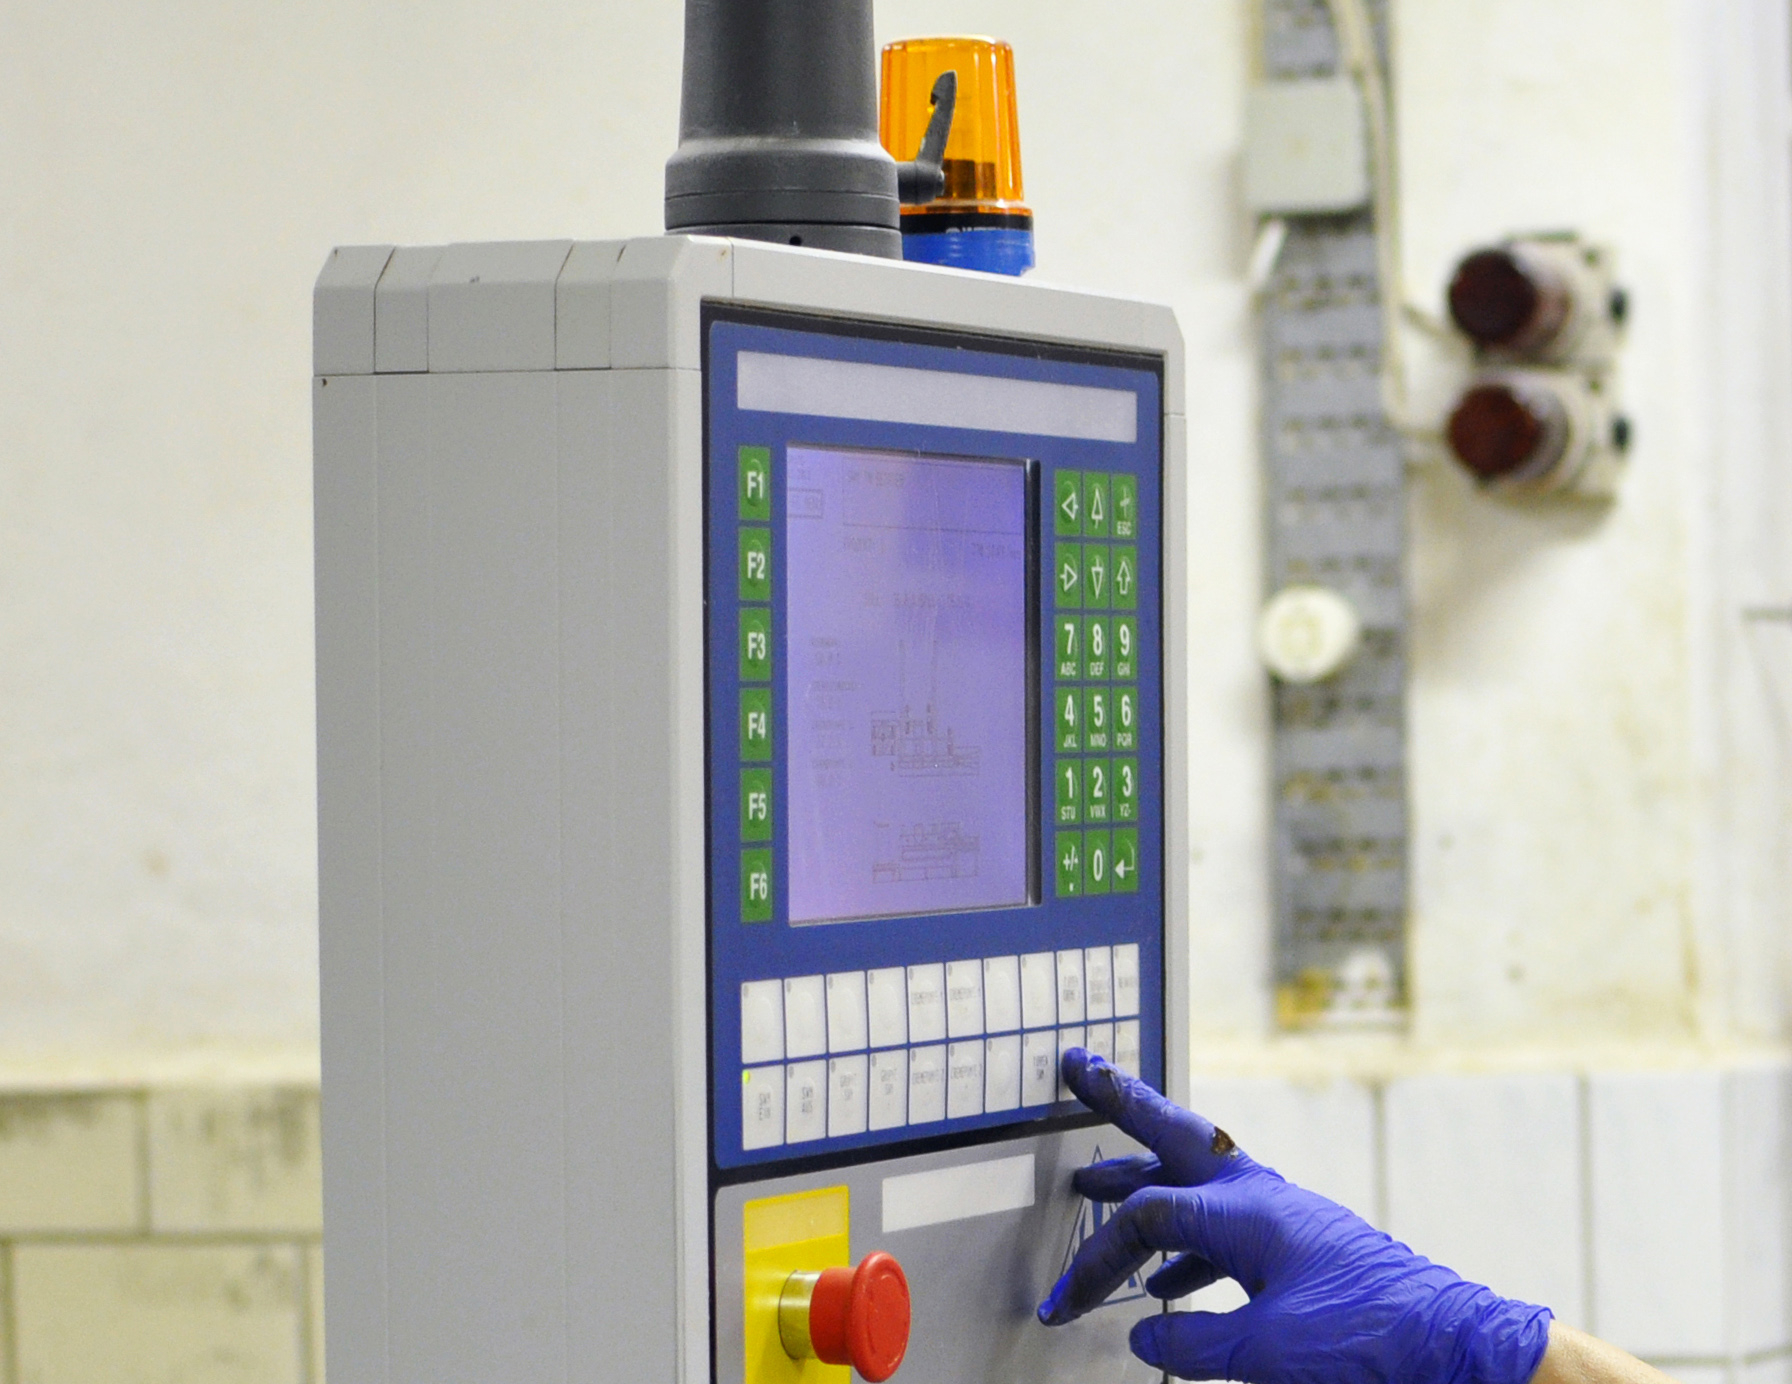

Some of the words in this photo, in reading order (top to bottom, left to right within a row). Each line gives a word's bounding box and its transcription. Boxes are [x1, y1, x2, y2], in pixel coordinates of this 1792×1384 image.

[747, 471, 764, 498] F1
[747, 552, 766, 579] F2
[747, 632, 766, 660] F3
[1064, 623, 1075, 655] 7
[1092, 623, 1102, 656] 8
[1120, 624, 1130, 656] 9
[1061, 662, 1076, 676] ABC
[1090, 662, 1104, 676] DEF
[748, 712, 766, 739] F4
[1064, 695, 1075, 727] 4
[1093, 695, 1103, 727] 5
[1121, 695, 1131, 726] 6
[1065, 766, 1074, 799] 1
[1092, 766, 1103, 798] 2
[1122, 765, 1132, 797] 3
[748, 792, 767, 820] F5
[1061, 806, 1076, 820] STU
[1093, 849, 1103, 881] 0
[749, 873, 768, 900] F6
